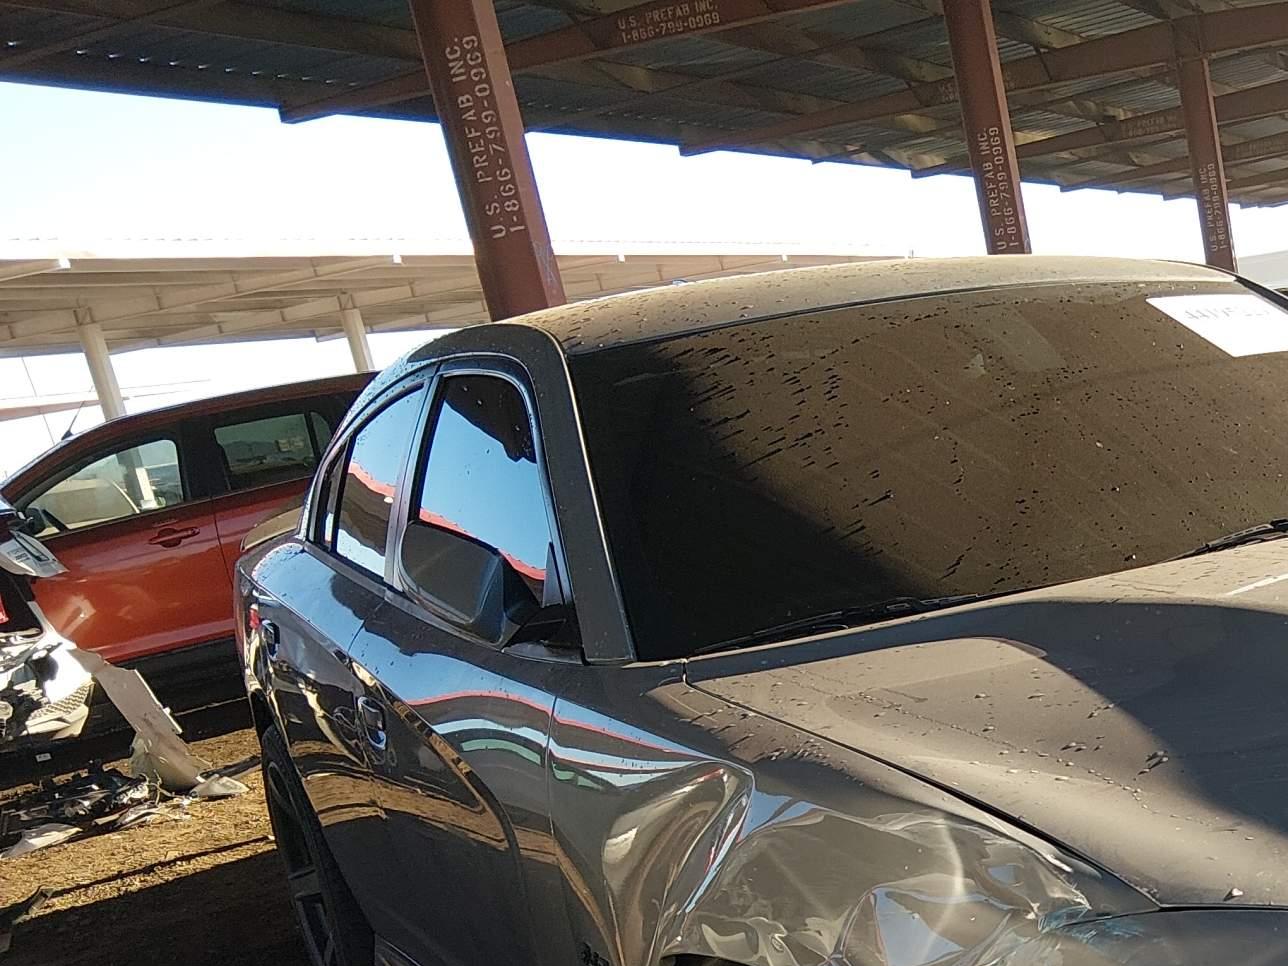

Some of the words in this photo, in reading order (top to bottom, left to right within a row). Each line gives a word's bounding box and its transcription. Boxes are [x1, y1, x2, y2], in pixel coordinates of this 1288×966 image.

[621, 12, 720, 43] 1-866-799-0969
[645, 4, 690, 24] PREFAB
[445, 37, 468, 83] INC.
[458, 94, 493, 183] PREFAB
[462, 35, 525, 233] 1-866-799-0969
[983, 162, 1002, 216] PREFAB
[485, 196, 507, 239] U.S.
